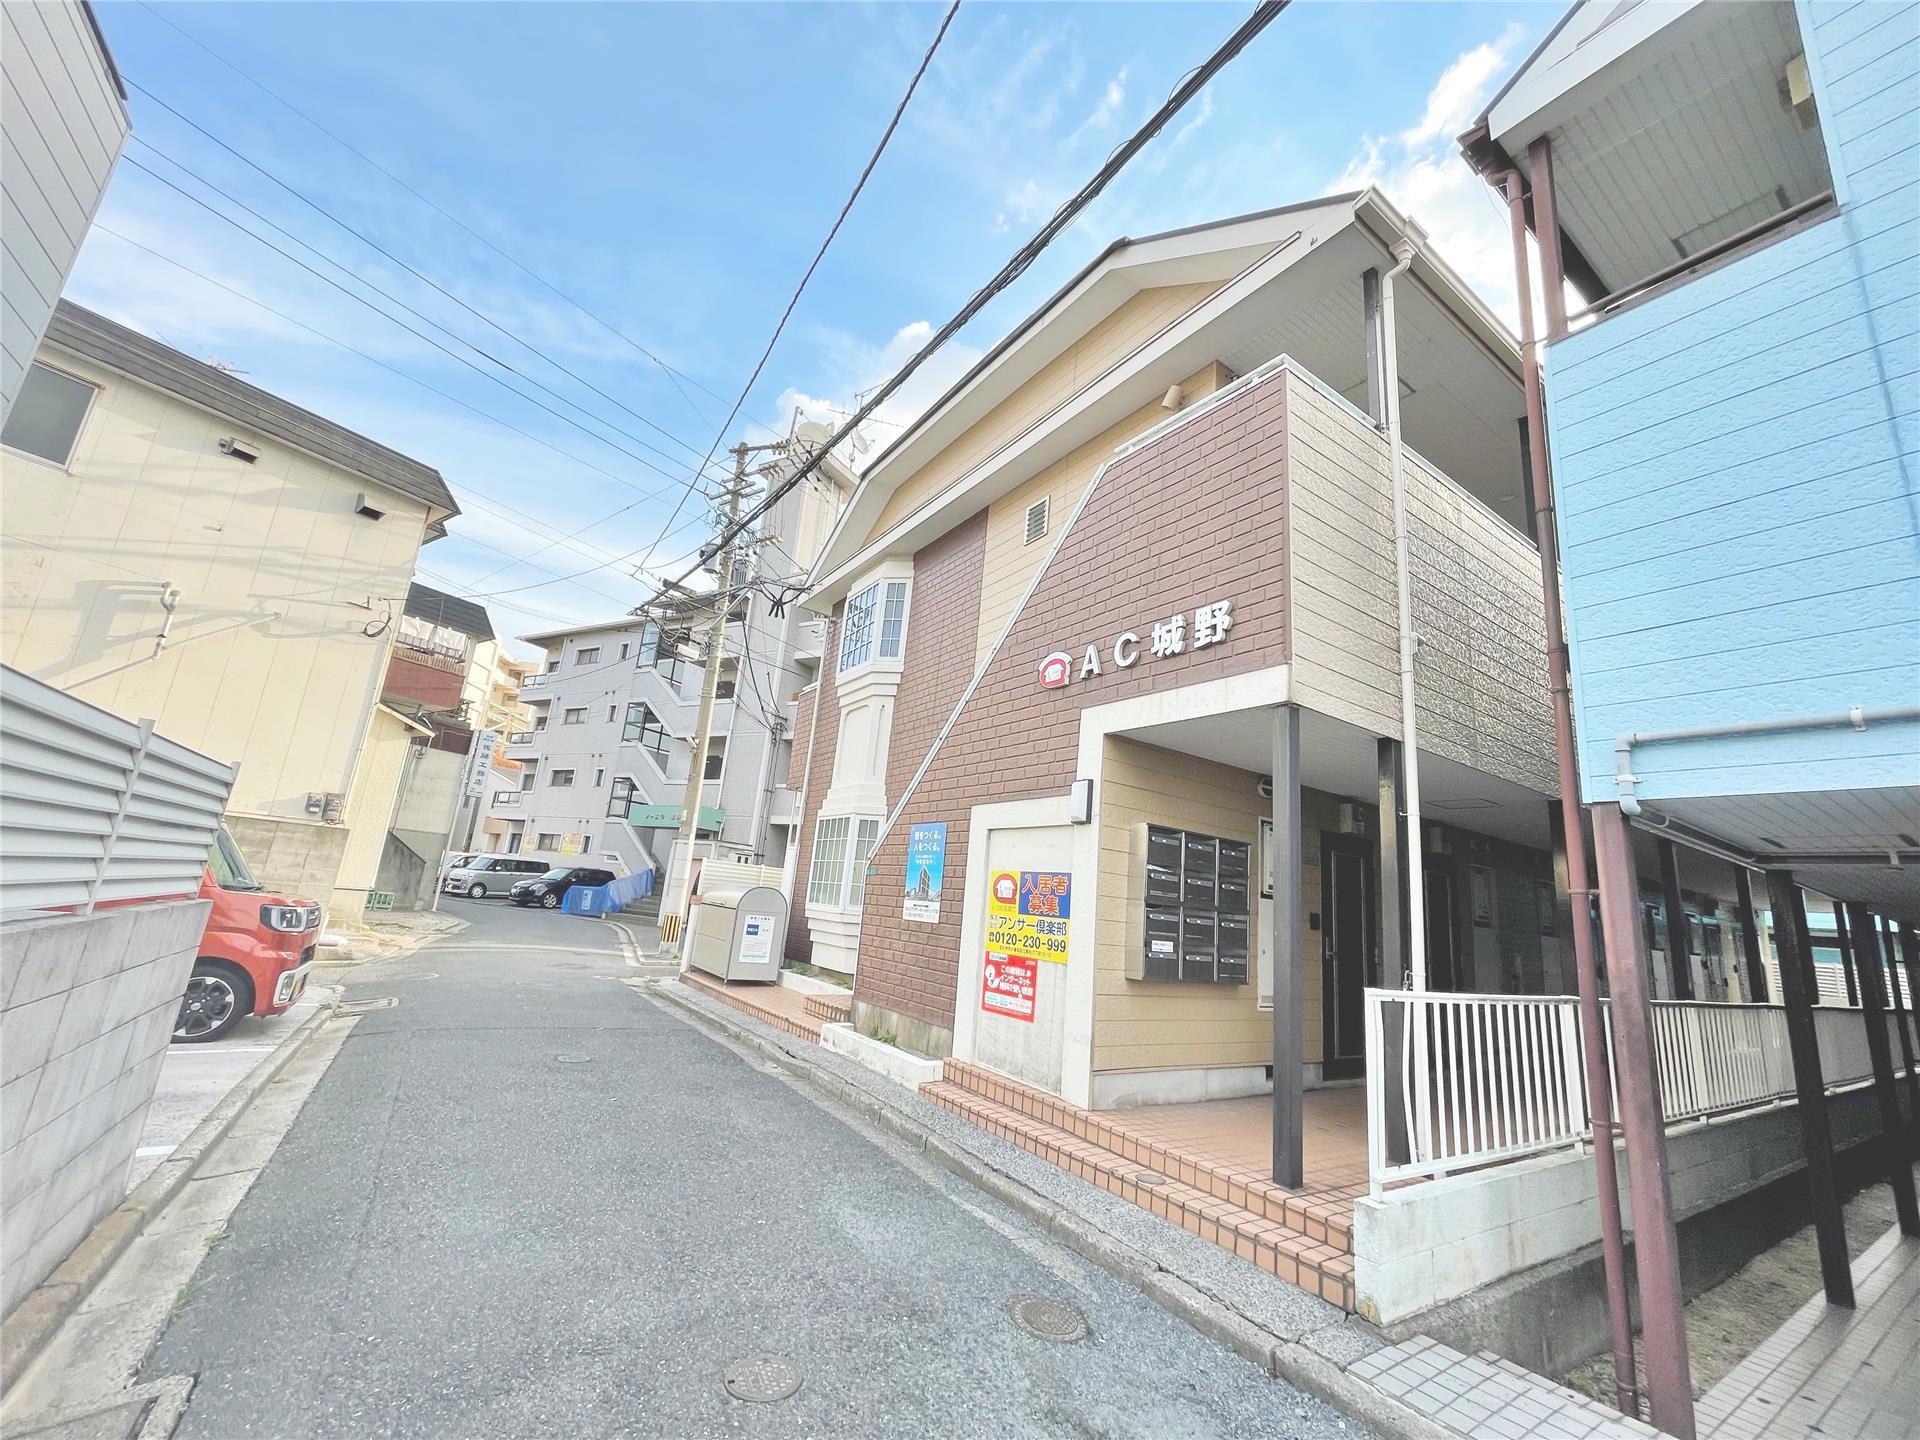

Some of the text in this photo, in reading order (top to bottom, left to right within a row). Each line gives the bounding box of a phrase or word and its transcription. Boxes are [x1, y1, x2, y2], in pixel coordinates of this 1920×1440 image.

[1021, 874, 1068, 895] 入居者
[1028, 894, 1059, 915] 募集
[998, 915, 1067, 936] アンサー倶楽部
[995, 931, 1067, 953] 0120-230-999
